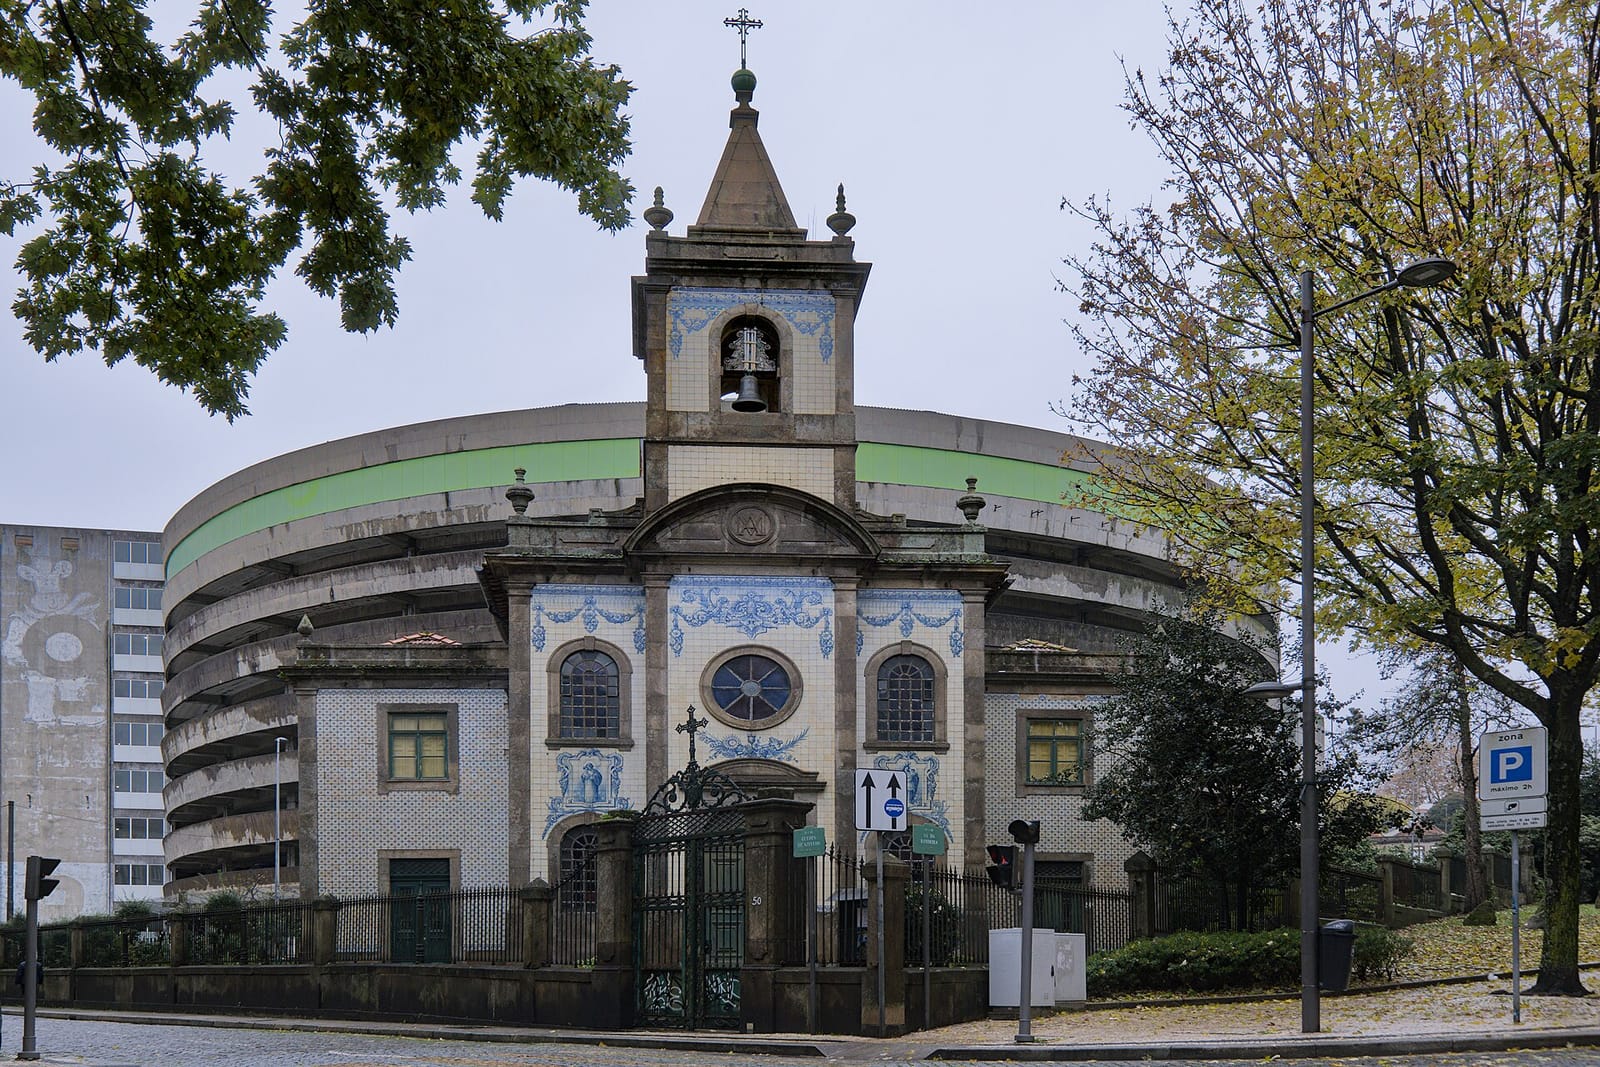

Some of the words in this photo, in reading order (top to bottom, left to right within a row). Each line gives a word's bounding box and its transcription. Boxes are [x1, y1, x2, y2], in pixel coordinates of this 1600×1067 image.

[1498, 732, 1524, 742] zona
[1499, 751, 1524, 780] P
[751, 896, 762, 906] 50
